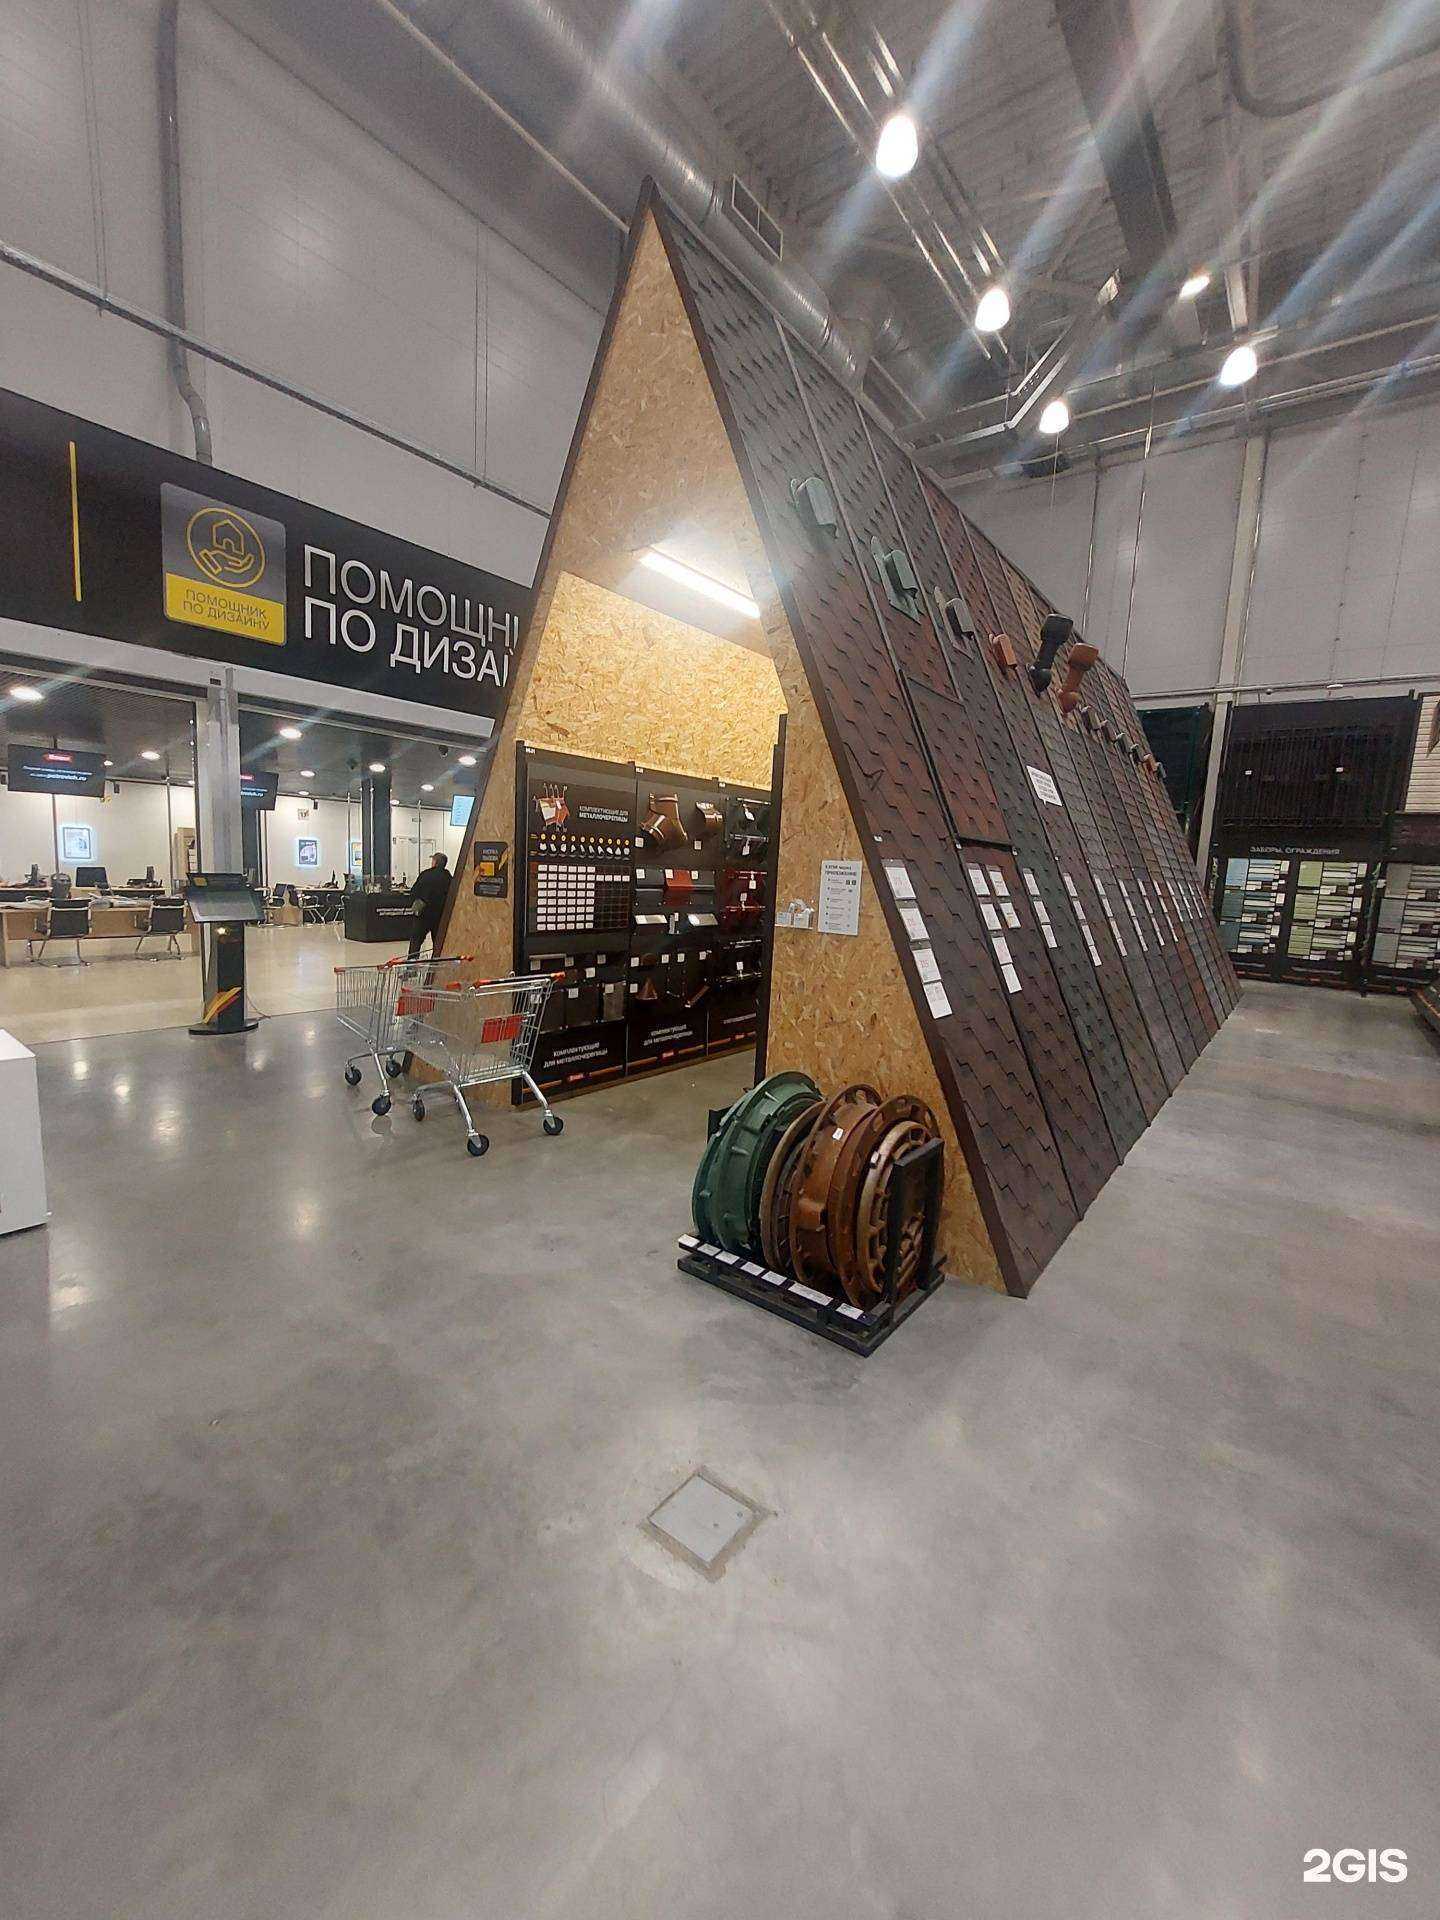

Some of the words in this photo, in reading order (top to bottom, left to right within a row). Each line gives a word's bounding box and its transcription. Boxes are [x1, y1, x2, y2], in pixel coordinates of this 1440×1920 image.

[183, 600, 204, 615] ПО
[207, 607, 270, 631] ДИЗАЙНУ
[185, 589, 267, 620] ПОМОЩНИК
[304, 595, 377, 653] ПО
